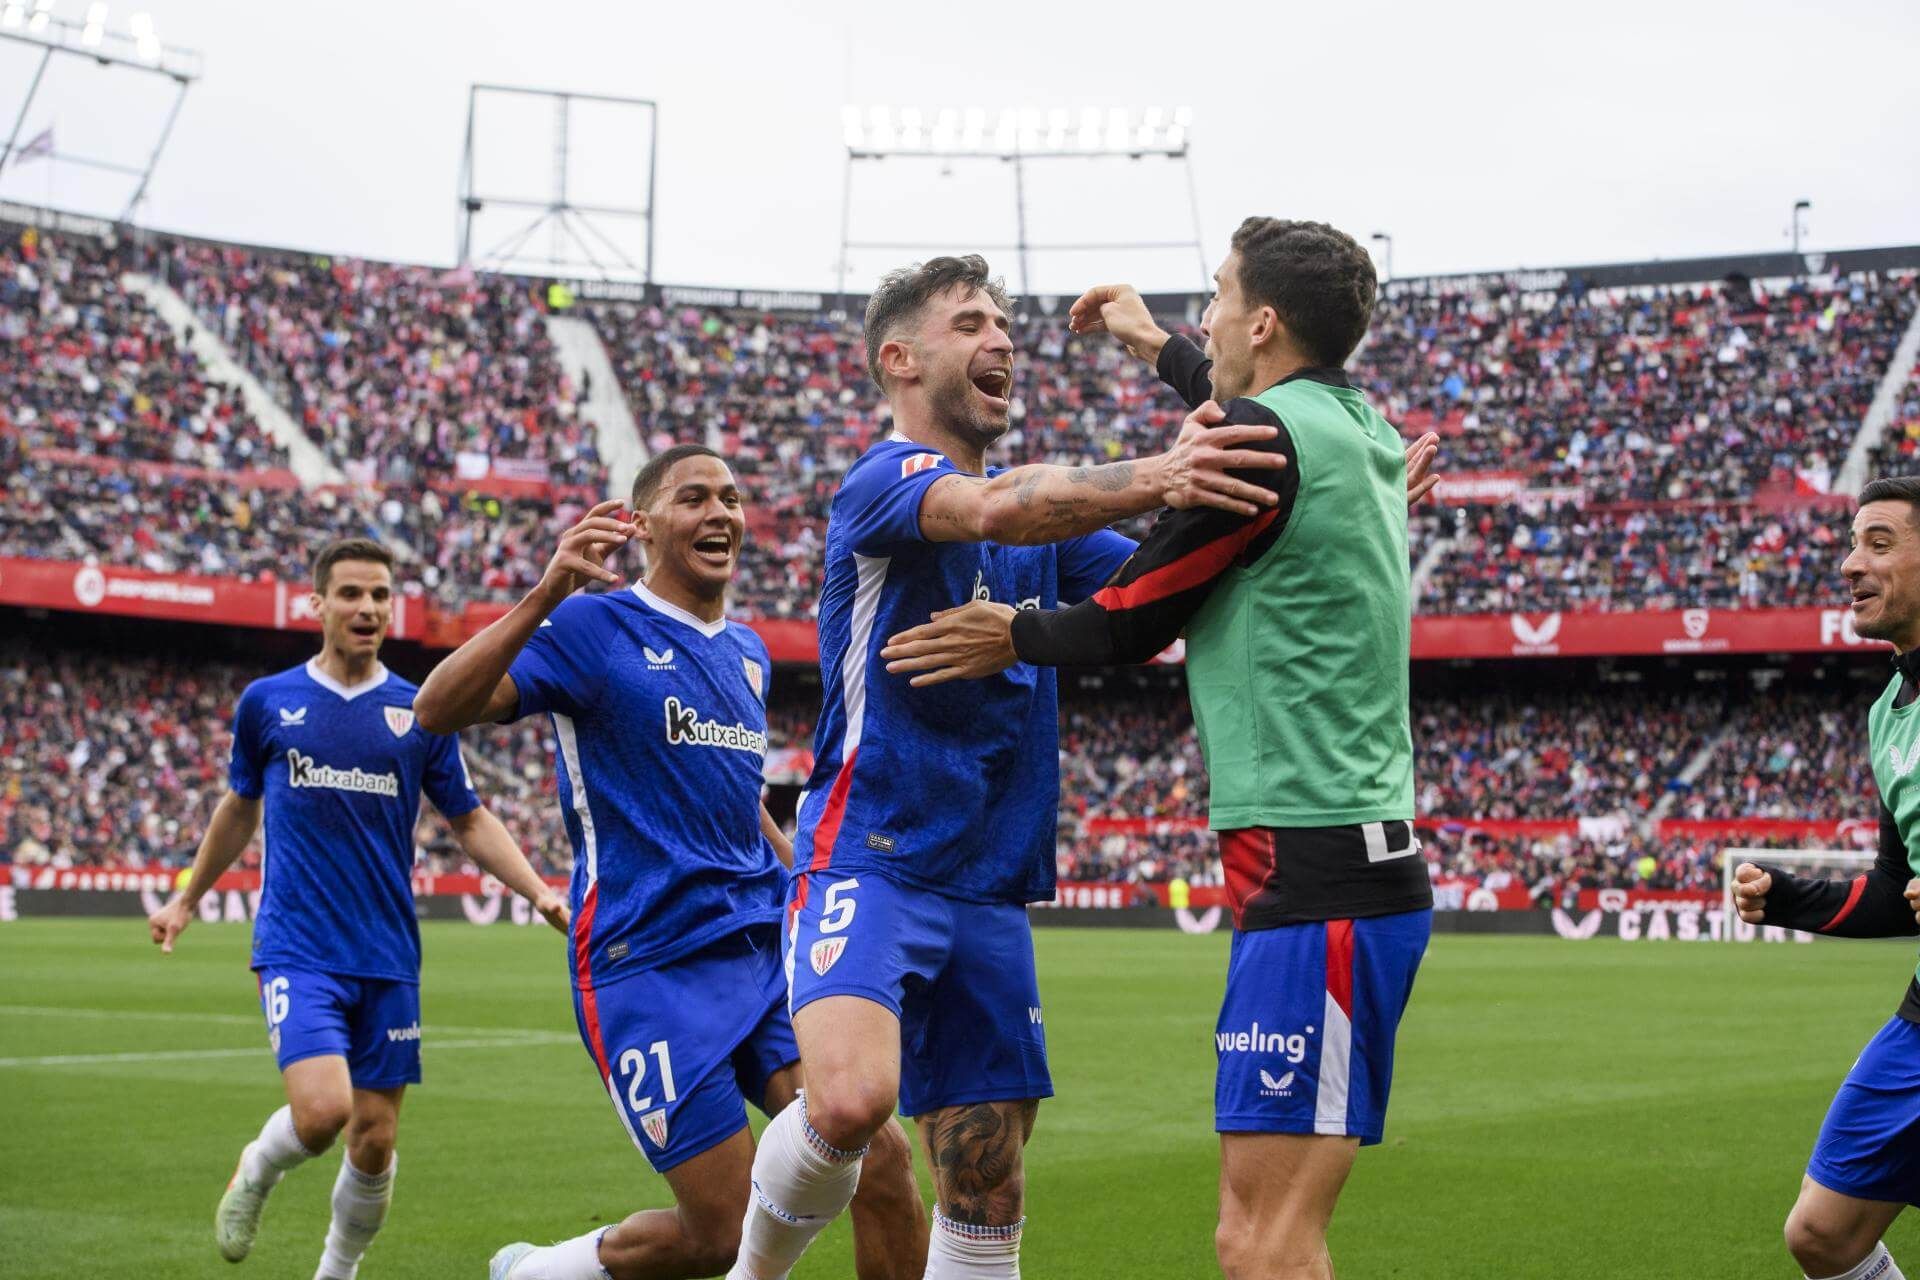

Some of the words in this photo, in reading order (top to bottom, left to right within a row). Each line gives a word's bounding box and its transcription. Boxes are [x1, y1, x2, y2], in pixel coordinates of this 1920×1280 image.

[666, 699, 767, 756] Kutxaban
[290, 749, 398, 796] Kutxabank
[819, 878, 860, 934] 5
[263, 976, 290, 1029] 16
[1216, 1022, 1306, 1063] vueling
[619, 1040, 677, 1113] 21
